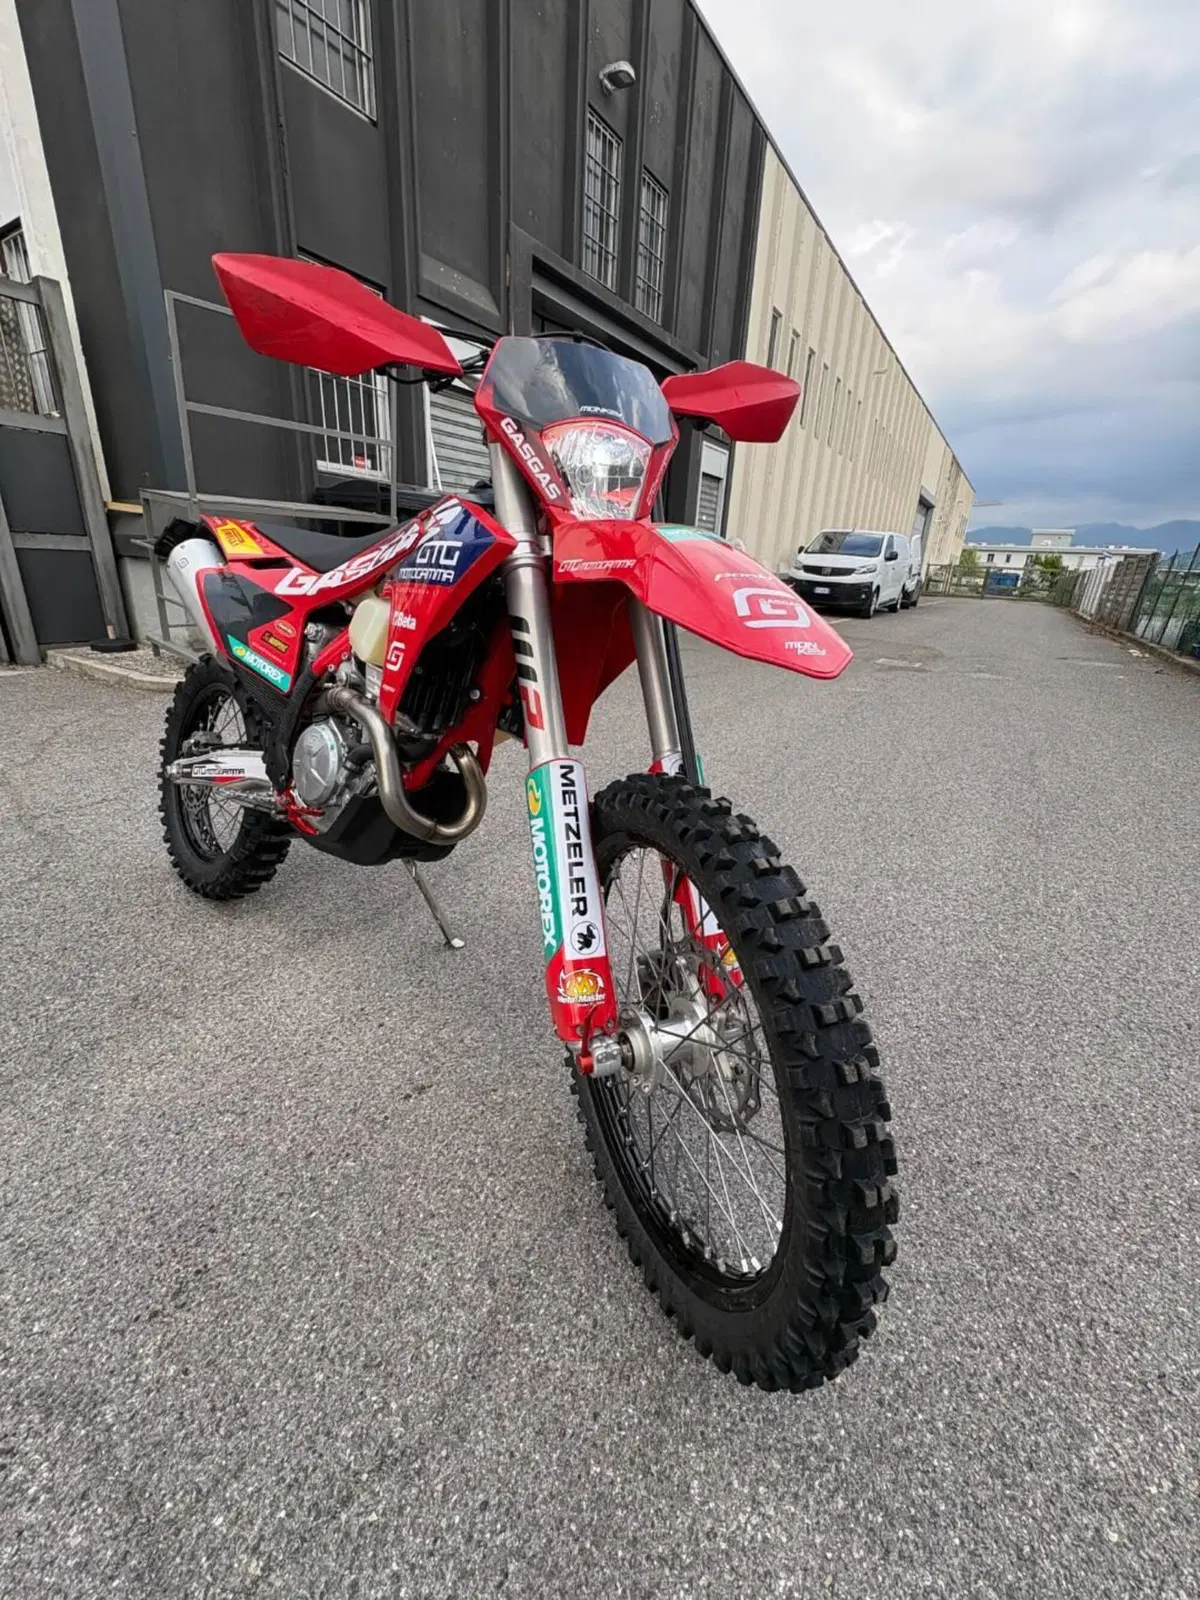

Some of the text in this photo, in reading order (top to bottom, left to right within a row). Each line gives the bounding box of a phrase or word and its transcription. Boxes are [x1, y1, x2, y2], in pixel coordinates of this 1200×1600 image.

[500, 417, 562, 500] GASGAS
[243, 650, 285, 683] MOTOREX
[530, 816, 558, 949] MOTOREX
[559, 764, 590, 917] METZELER
